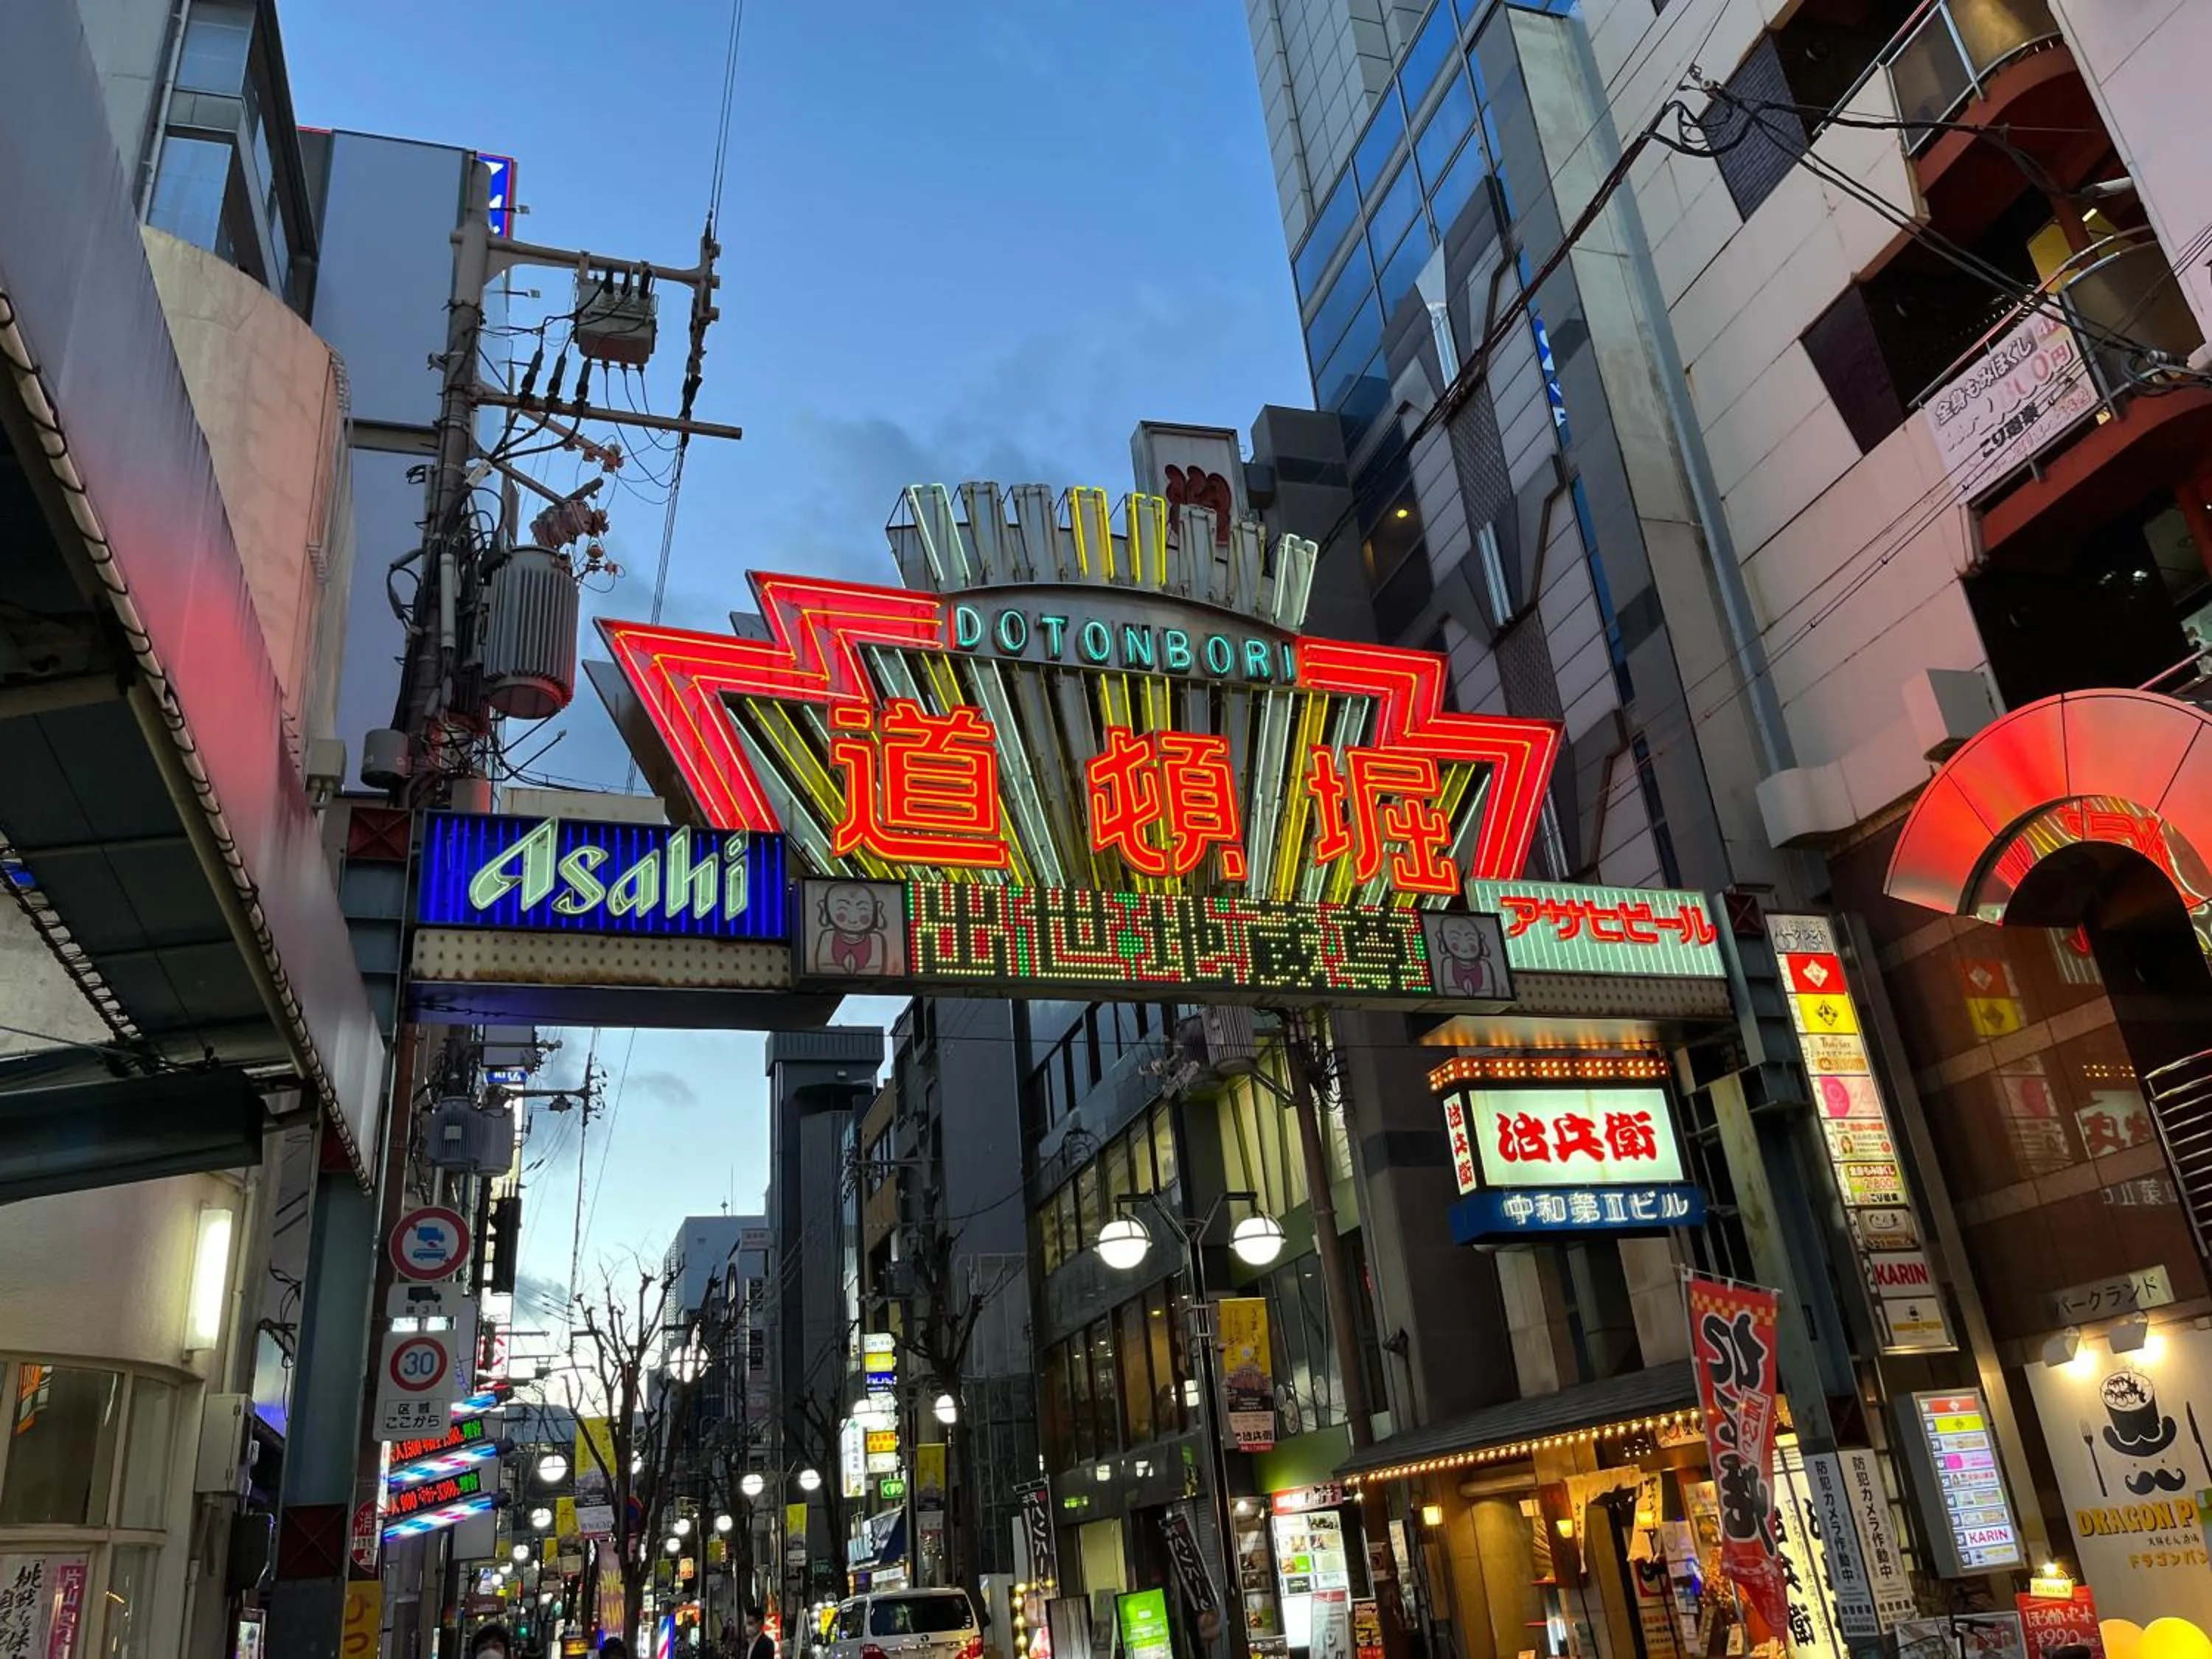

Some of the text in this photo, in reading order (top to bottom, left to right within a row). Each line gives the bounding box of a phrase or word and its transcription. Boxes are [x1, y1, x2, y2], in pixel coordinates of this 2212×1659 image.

[1933, 337, 2033, 425] 全身もみほぐし
[955, 605, 1295, 681] DOTONBORI
[828, 698, 1460, 895] 道頓堀
[467, 816, 750, 921] Asahi
[914, 882, 1419, 990] 出世地蔵尊
[1500, 897, 1717, 945] アサヒビール
[1447, 1104, 1474, 1189] 治兵衛
[1496, 1110, 1658, 1164] 治兵衛
[1874, 1263, 1930, 1285] KARIN
[403, 1352, 435, 1376] 30
[386, 1416, 440, 1429] ここから
[1815, 1461, 1854, 1583] 防犯カメラ作動中
[1851, 1455, 1893, 1579] 防犯カメラ作動中
[1968, 1528, 2008, 1545] KARIN
[2076, 1500, 2177, 1537] DRAGON
